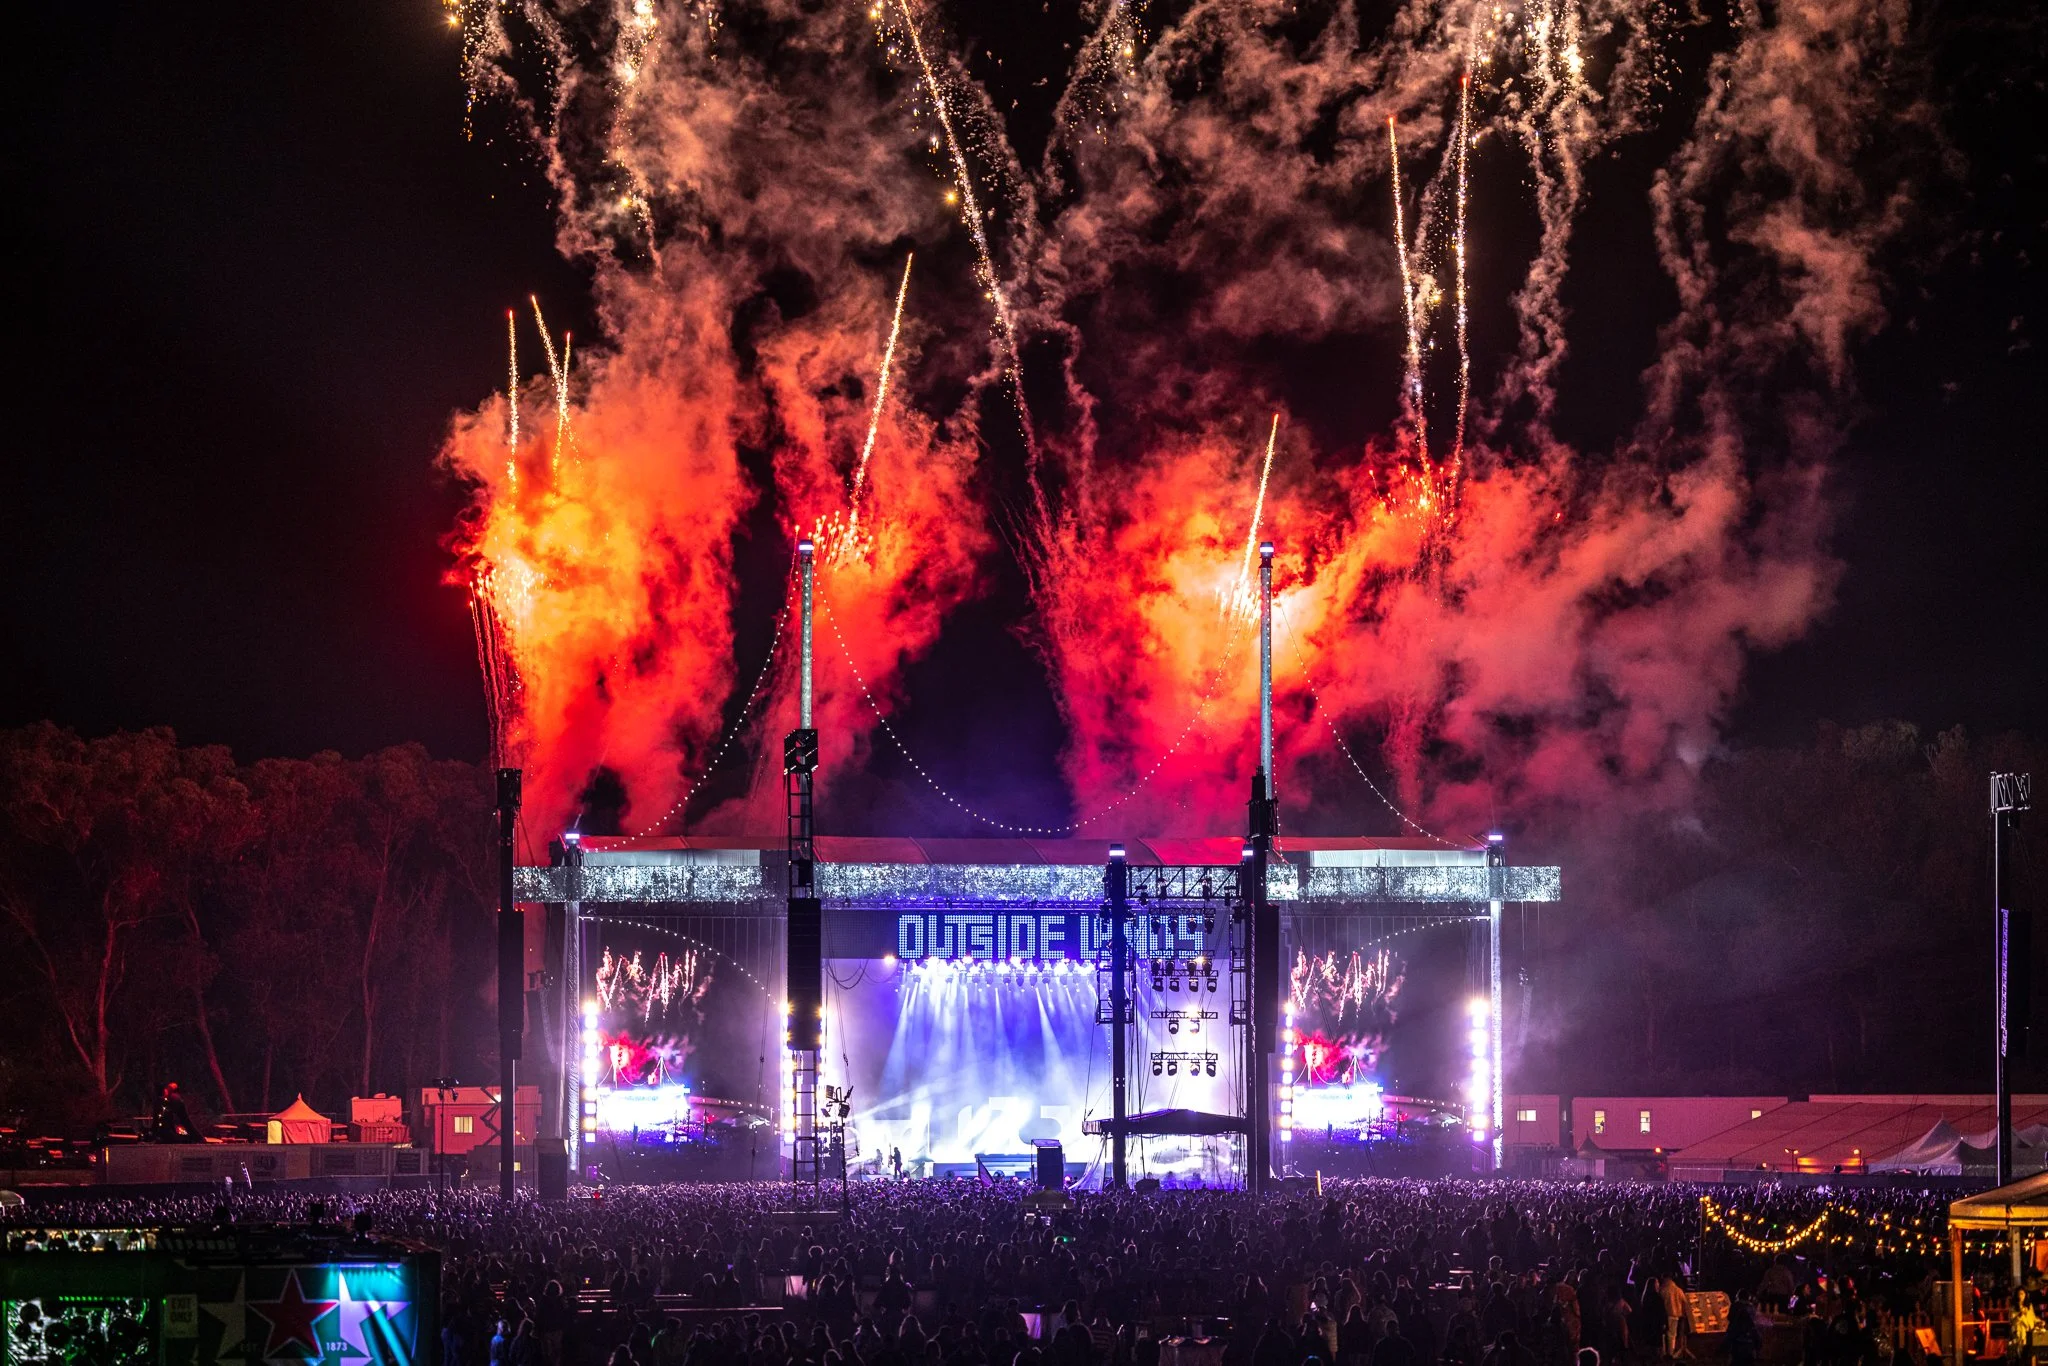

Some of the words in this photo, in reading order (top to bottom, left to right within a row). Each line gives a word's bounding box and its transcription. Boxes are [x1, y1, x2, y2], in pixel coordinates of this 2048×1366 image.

[899, 914, 1065, 959] OUTSIDE
[171, 1297, 192, 1310] EXIT
[326, 1342, 348, 1352] 1873
